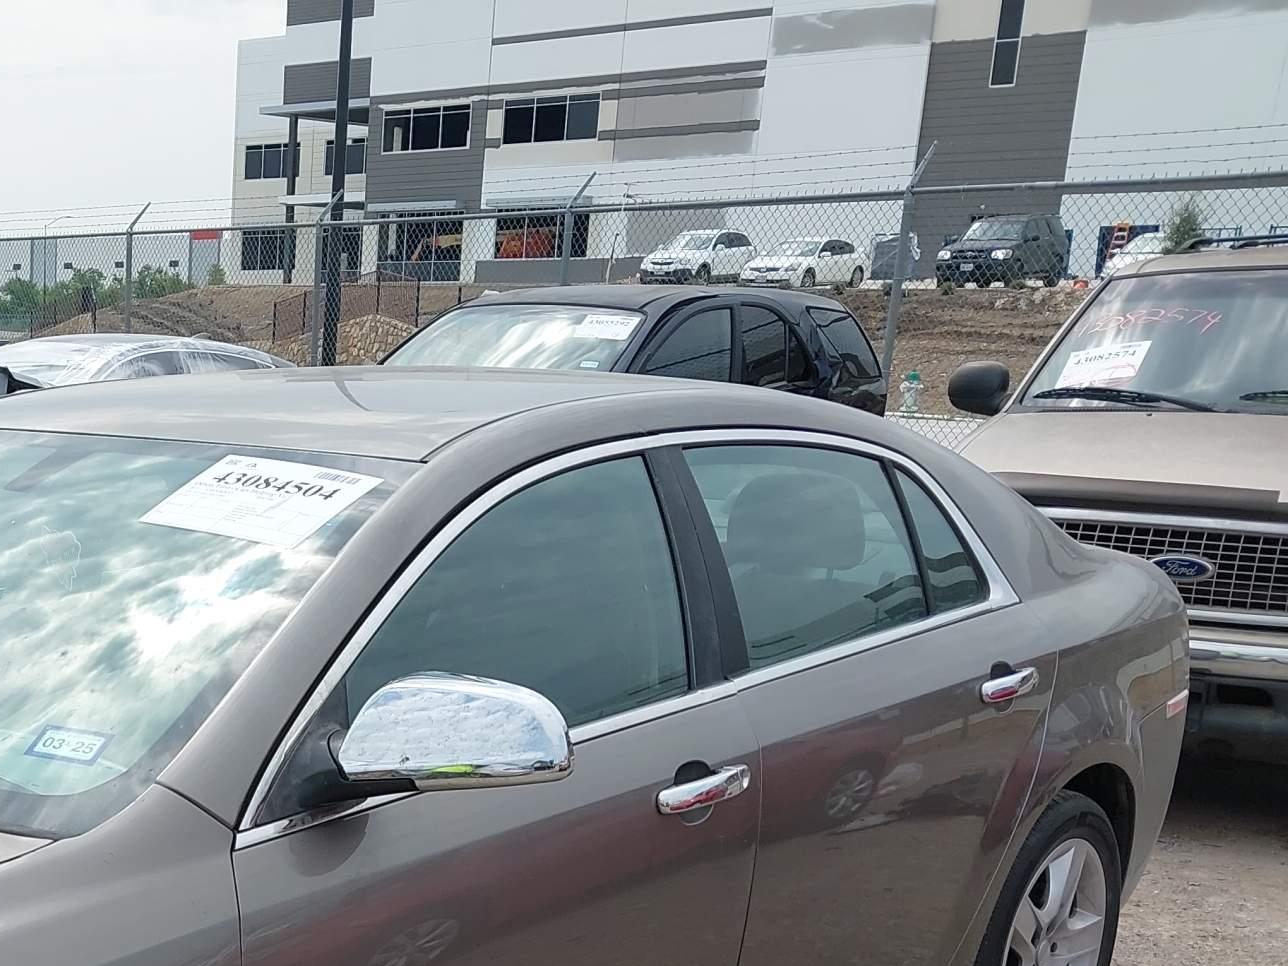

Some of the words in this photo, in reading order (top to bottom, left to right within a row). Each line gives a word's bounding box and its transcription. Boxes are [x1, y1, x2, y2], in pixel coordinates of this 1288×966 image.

[213, 471, 342, 500] 43084504
[1162, 560, 1198, 576] Ford
[42, 737, 66, 750] 03
[71, 741, 97, 754] 25
